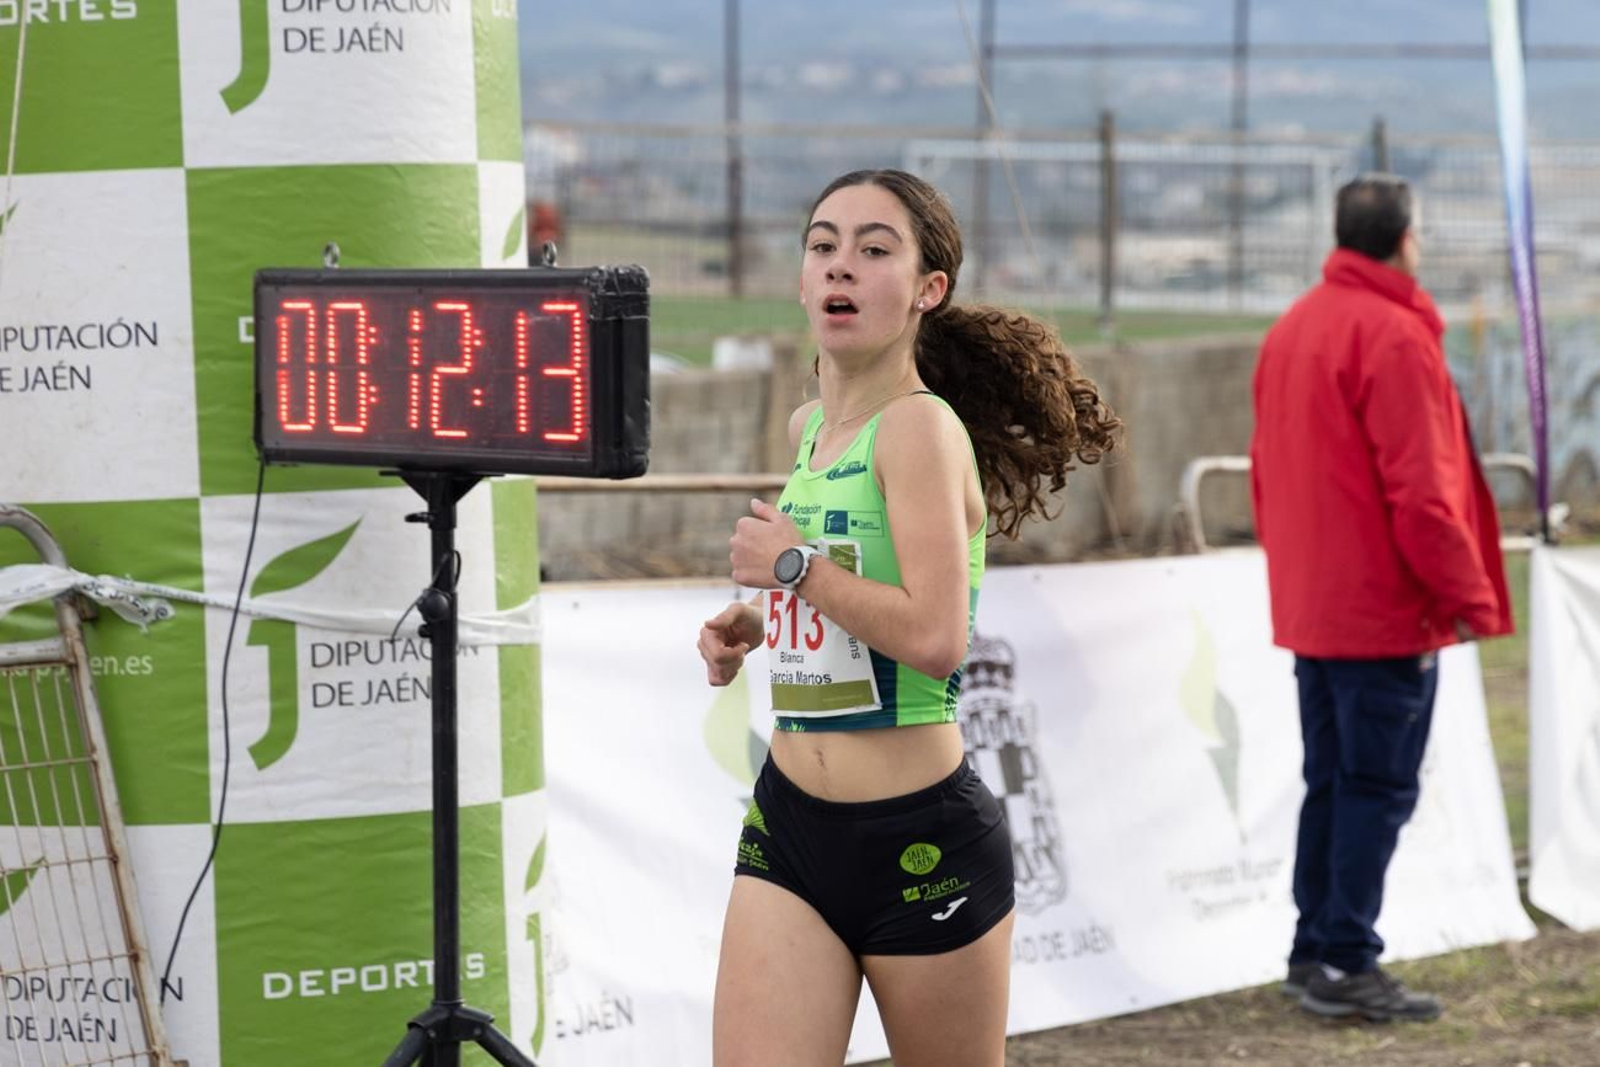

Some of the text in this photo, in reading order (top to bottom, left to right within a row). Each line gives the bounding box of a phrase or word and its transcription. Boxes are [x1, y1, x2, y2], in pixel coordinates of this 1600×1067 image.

[283, 22, 404, 53] DE JAÉN
[18, 361, 92, 392] JAÉN
[766, 590, 824, 651] 513
[780, 651, 804, 664] Blanca
[312, 672, 433, 709] DE JAÉN
[796, 671, 832, 685] Martos
[5, 976, 184, 1004] DIPUTACIN
[263, 952, 486, 1000] DEPORTS
[6, 1012, 117, 1043] DE JAÉN
